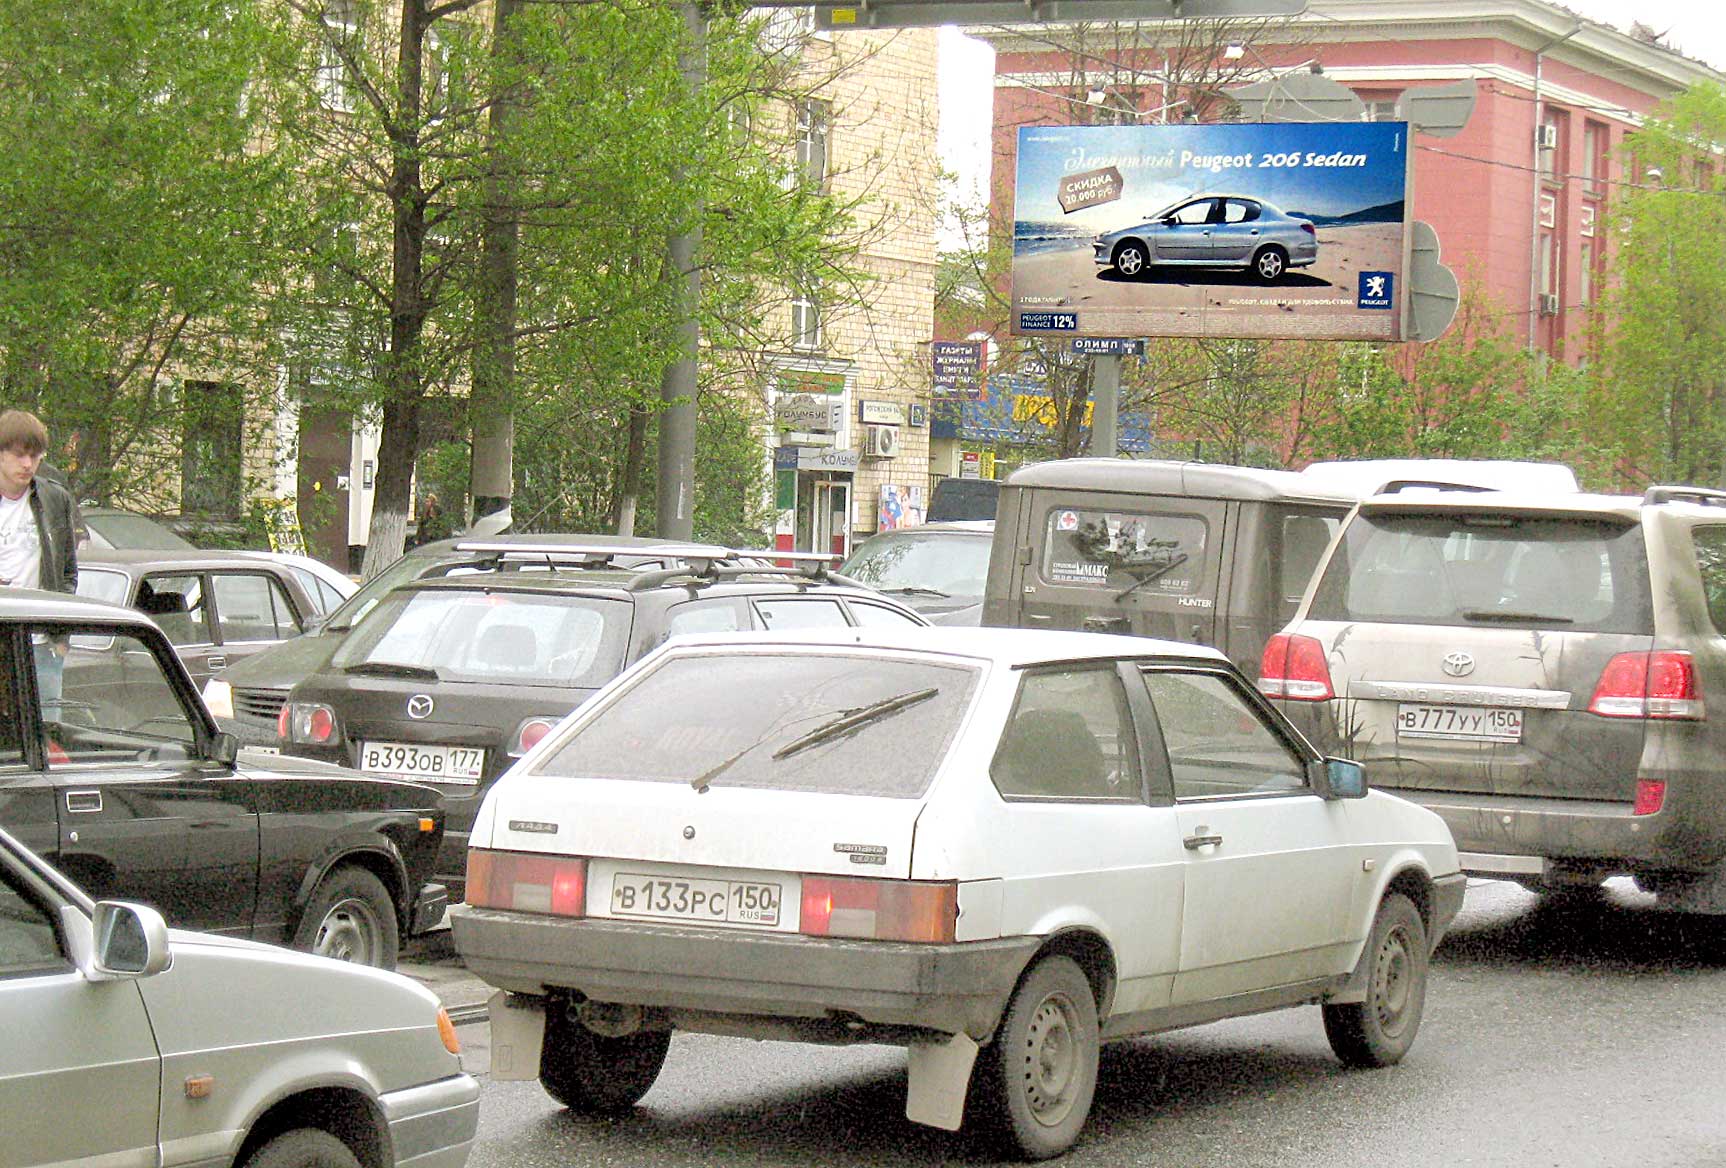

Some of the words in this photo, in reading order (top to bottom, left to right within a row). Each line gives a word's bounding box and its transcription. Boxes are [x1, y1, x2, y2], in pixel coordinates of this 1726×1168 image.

[1179, 151, 1253, 173] Peugeot
[1258, 152, 1302, 168] 206
[1303, 151, 1367, 167] Sedan
[1066, 174, 1113, 193] СКИДКА
[1053, 315, 1075, 328] 12%
[1075, 340, 1118, 349] ОЛИМП
[1178, 597, 1212, 608] HUNTER
[1378, 686, 1428, 700] LAND
[1443, 690, 1539, 706] CRUISER
[1488, 711, 1517, 728] 150
[449, 750, 479, 768] 177
[732, 885, 772, 910] 150
[739, 910, 760, 920] RUS
